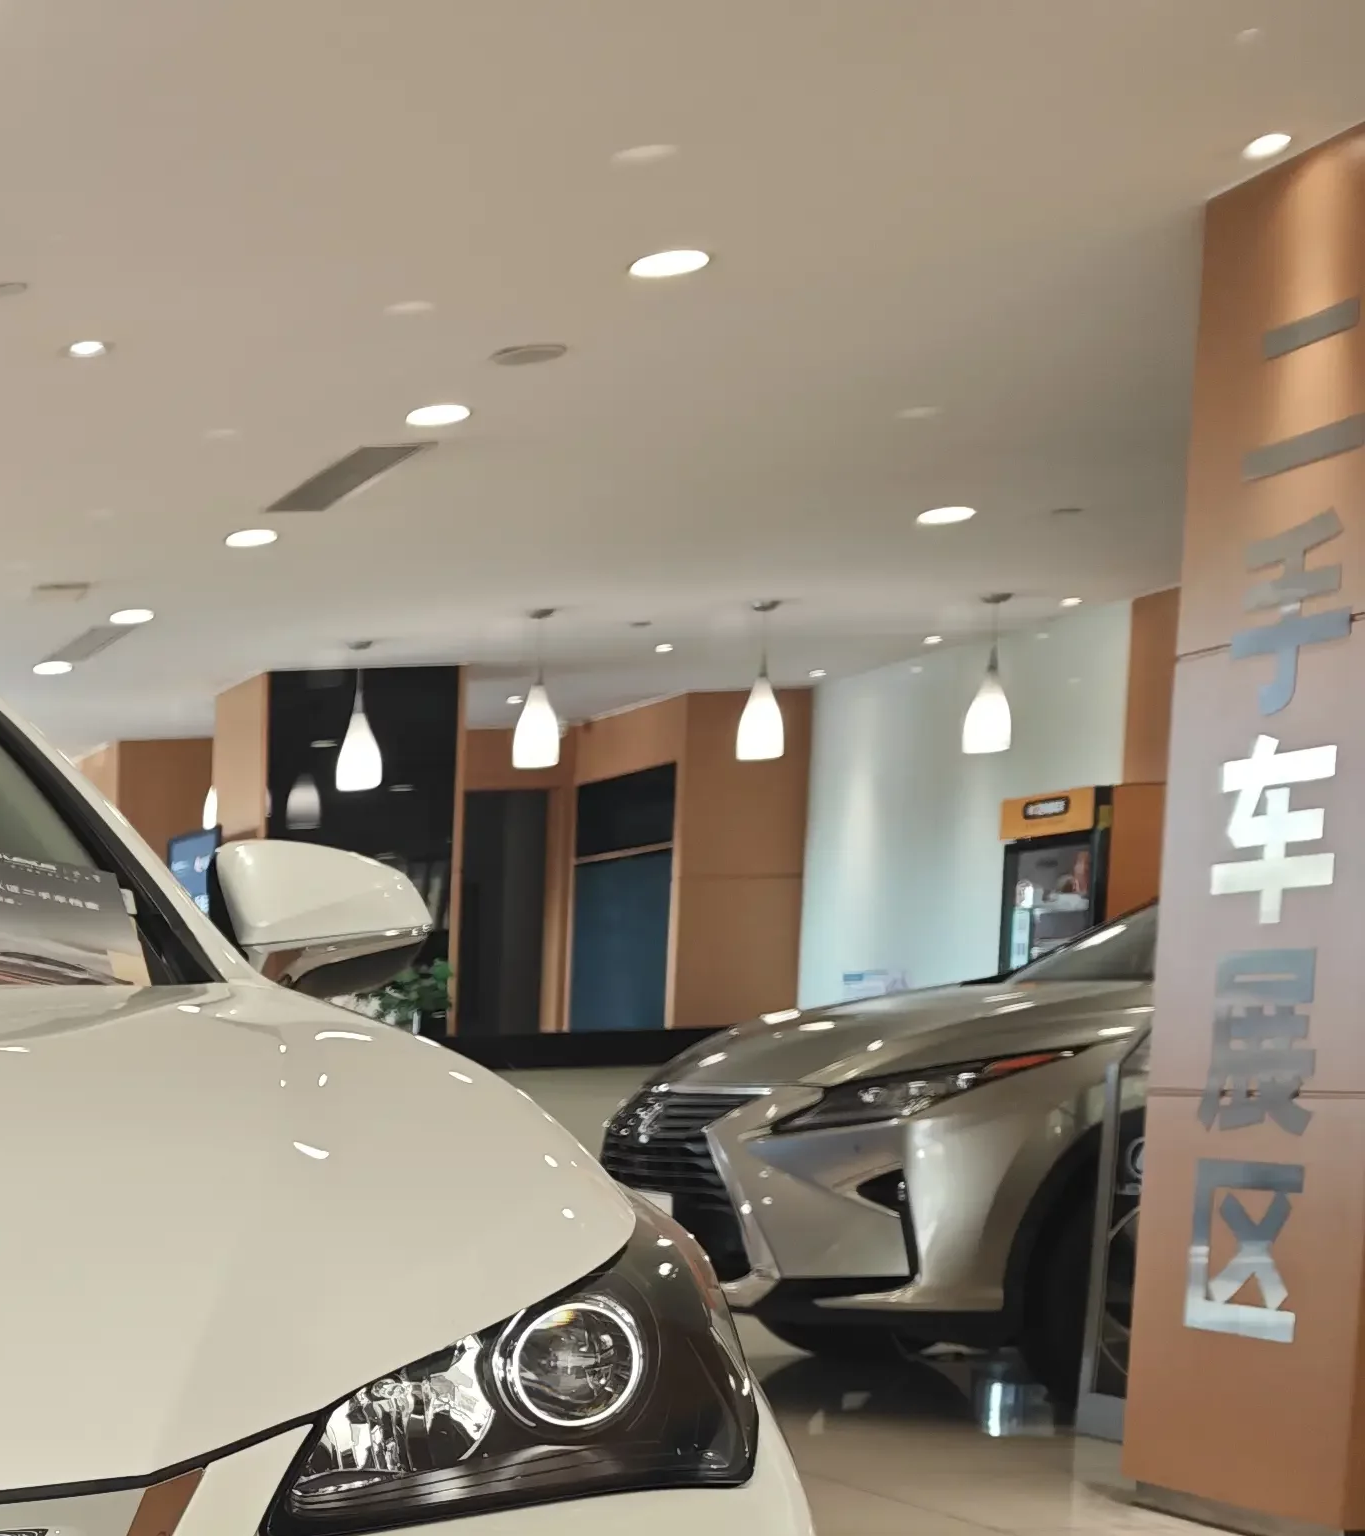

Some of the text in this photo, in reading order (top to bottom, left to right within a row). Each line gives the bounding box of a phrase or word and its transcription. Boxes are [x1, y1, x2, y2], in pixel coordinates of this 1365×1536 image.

[1183, 296, 1365, 1343] 二手车展区
